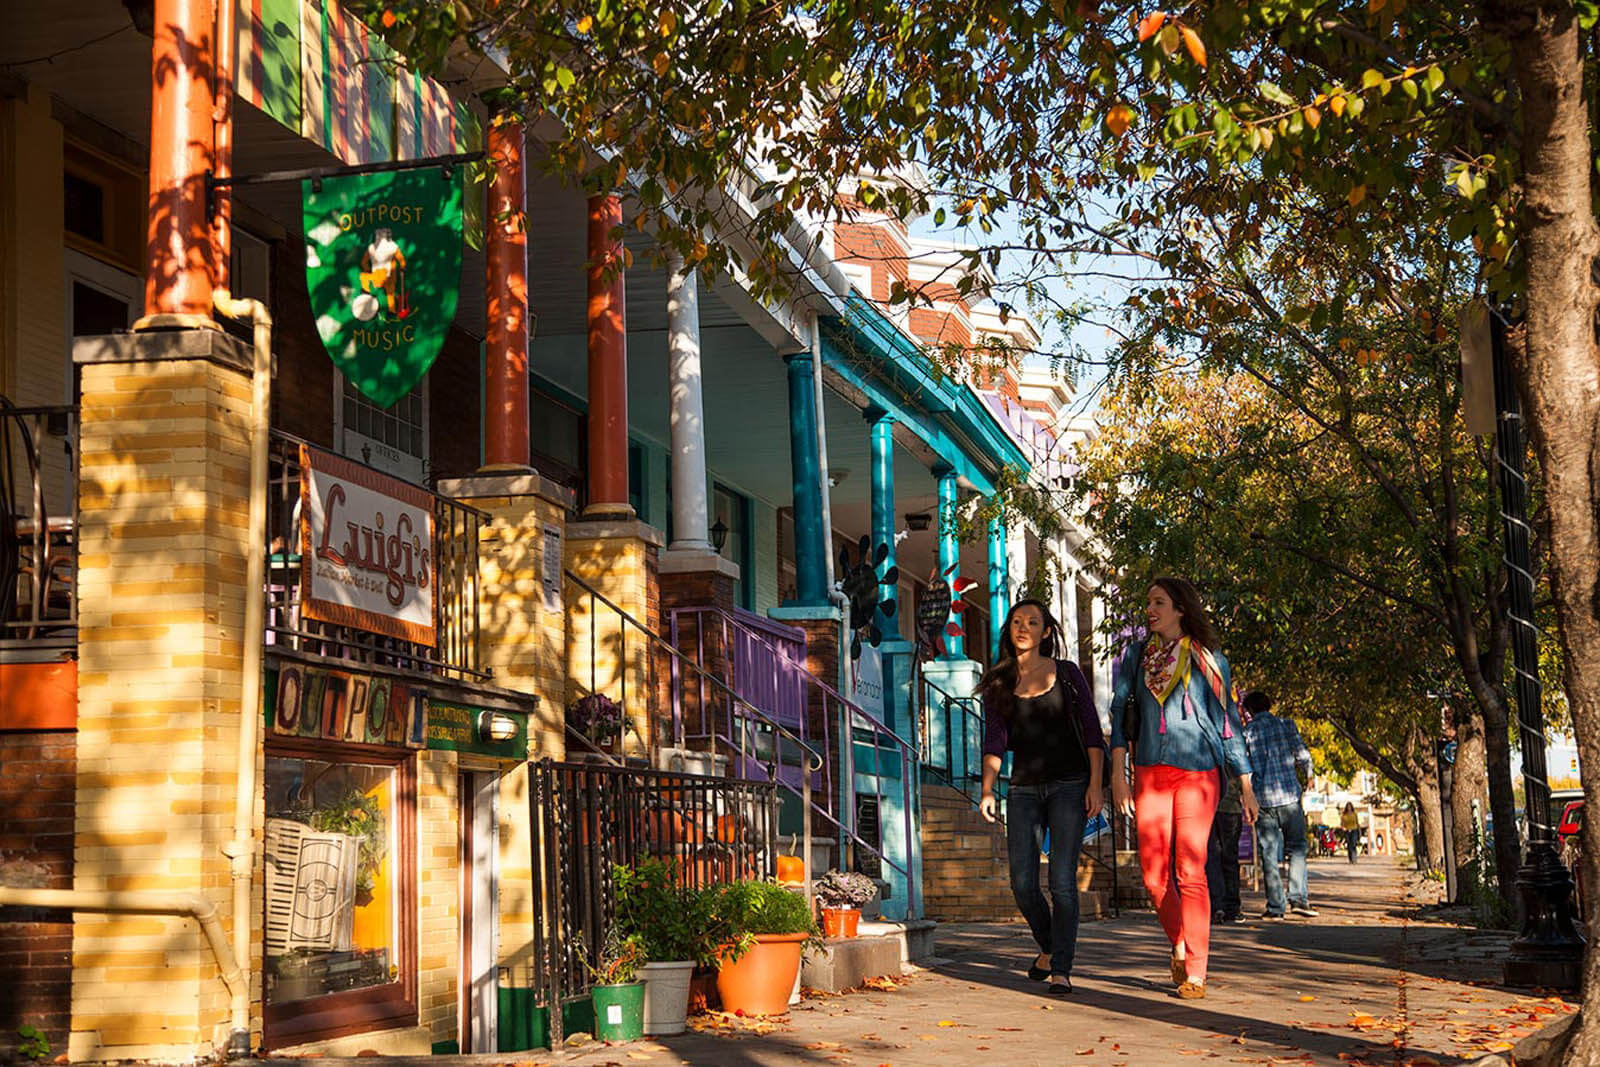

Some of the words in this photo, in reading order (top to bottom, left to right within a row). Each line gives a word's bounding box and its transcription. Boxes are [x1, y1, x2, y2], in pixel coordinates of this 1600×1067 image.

[338, 205, 423, 232] OUTPOST
[352, 325, 414, 350] MUSIC
[316, 483, 430, 607] Luigi's
[277, 667, 429, 743] OUTPOST
